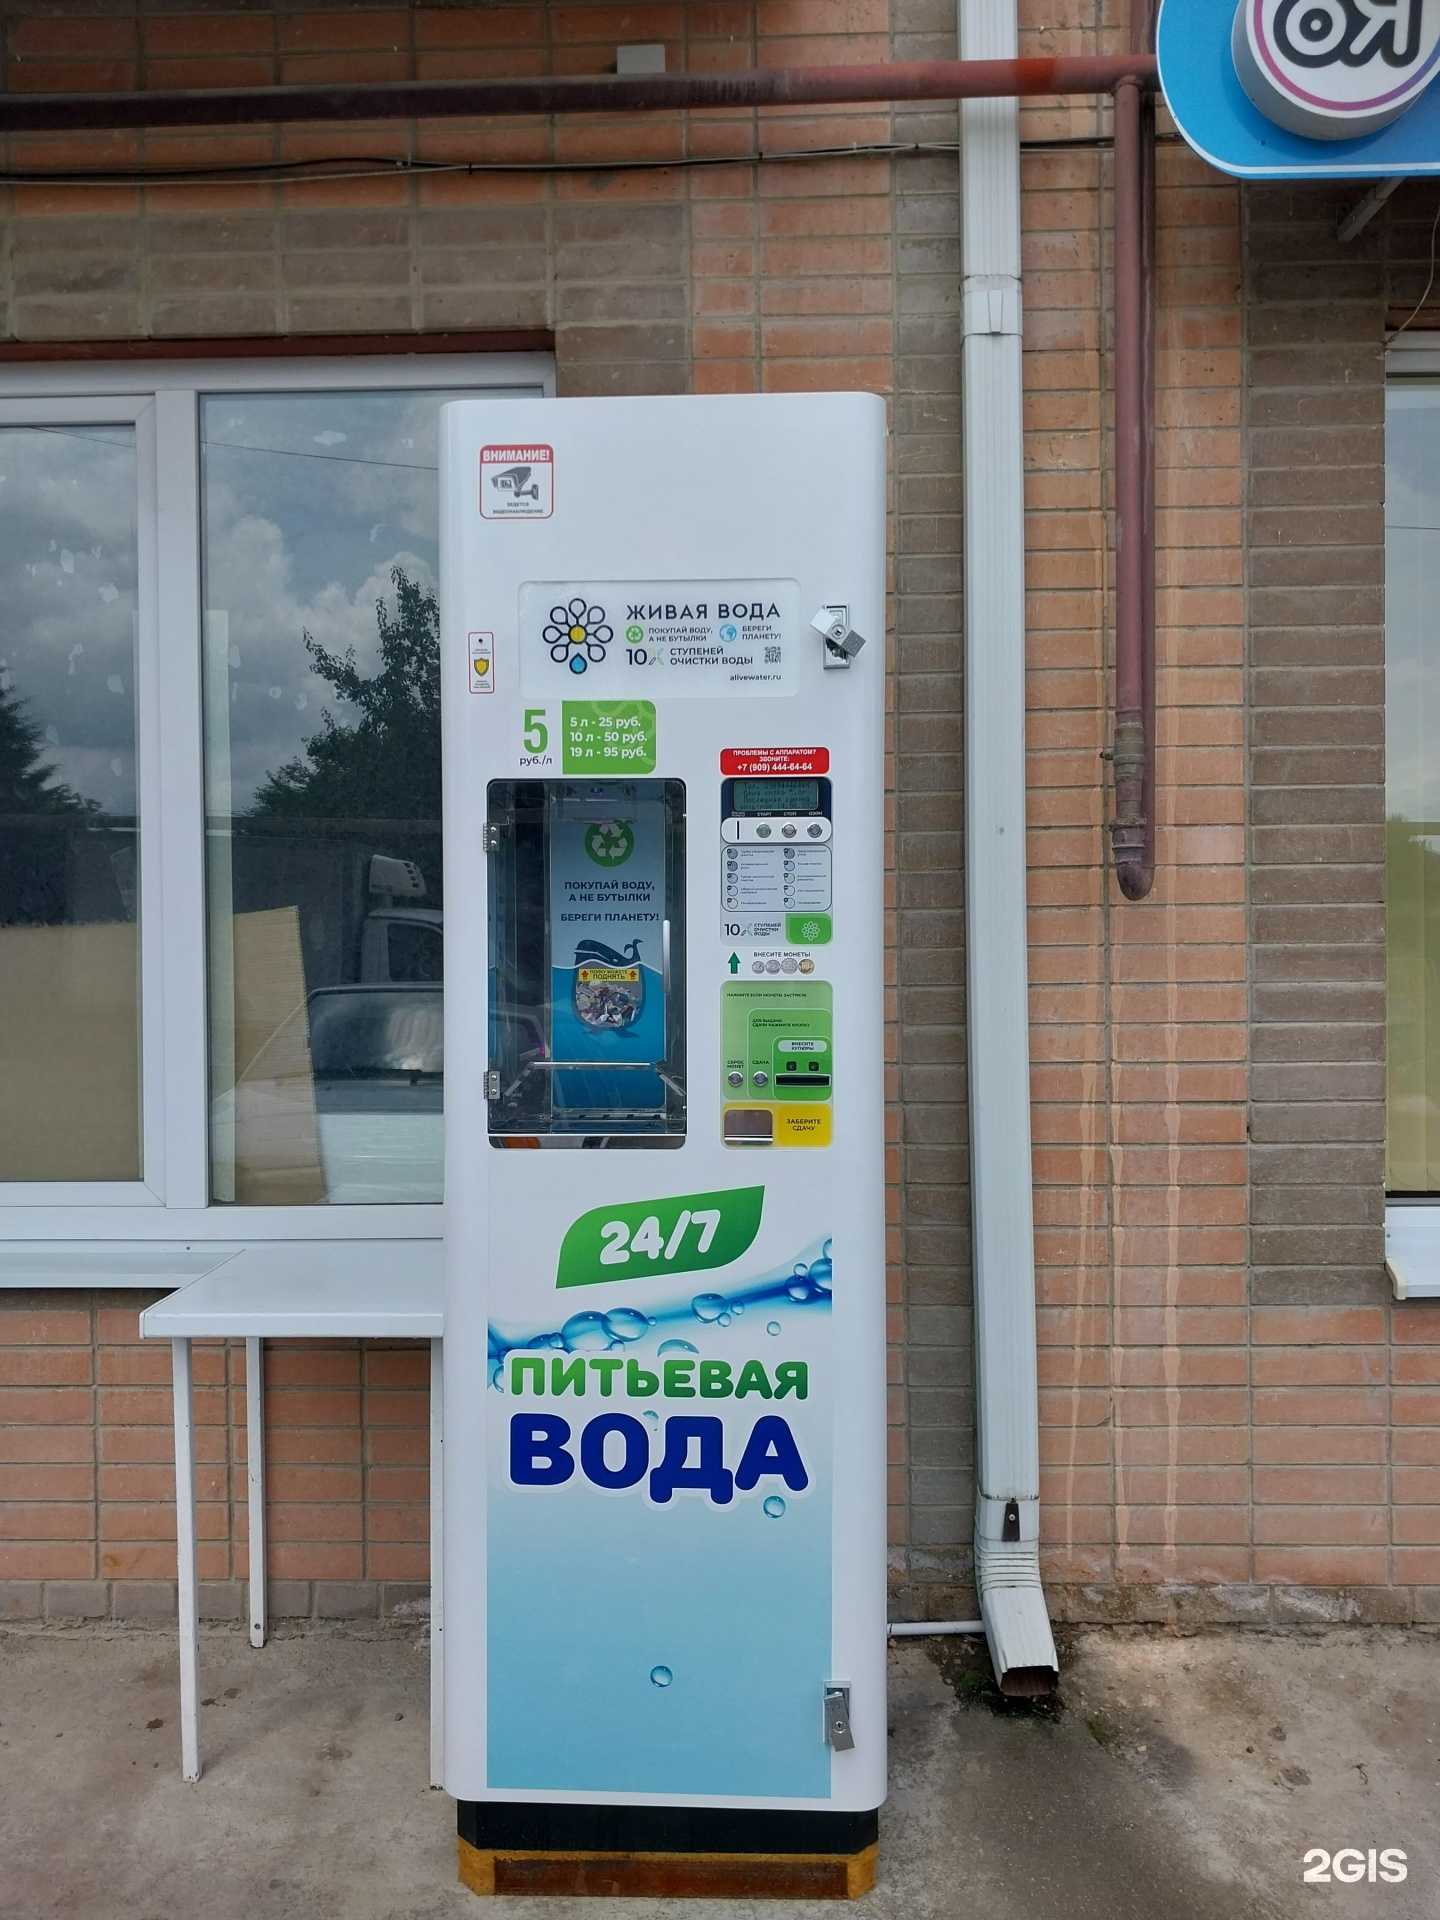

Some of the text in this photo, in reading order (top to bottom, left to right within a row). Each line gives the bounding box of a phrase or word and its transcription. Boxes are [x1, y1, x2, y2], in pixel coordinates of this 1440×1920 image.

[482, 449, 550, 462] ВНИМАНИЕ!
[626, 603, 781, 620] ЖИВАЯ ВОДА
[648, 626, 713, 634] ПОКУПАЙ ВОДУ,
[742, 633, 782, 641] ПЛАНЕТУ!
[670, 645, 724, 656] СТУПЕНЕЙ
[670, 657, 753, 666] ОЧИСТКИ ВОДЫ
[570, 717, 578, 727] 5
[580, 718, 589, 727] л
[599, 717, 613, 727] 25
[616, 717, 641, 727] руб.
[523, 709, 549, 754] 5
[570, 732, 582, 742] 10
[585, 733, 594, 742] л
[604, 732, 619, 742] 50
[622, 731, 648, 743] руб.
[570, 747, 582, 757] 19
[585, 748, 593, 757] л
[604, 747, 618, 757] 95
[621, 747, 647, 758] руб.
[519, 754, 553, 766] руб./л
[564, 881, 655, 891] ПОКУПАЙ ВОДУ,
[597, 894, 650, 902] БУТЫЛКИ
[604, 913, 660, 922] ПЛАНЕТУ!
[724, 924, 740, 936] 10
[599, 1210, 721, 1265] 24/7
[510, 1356, 809, 1400] ПИТЬЕВАЯ
[509, 1412, 810, 1505] ВОДА
